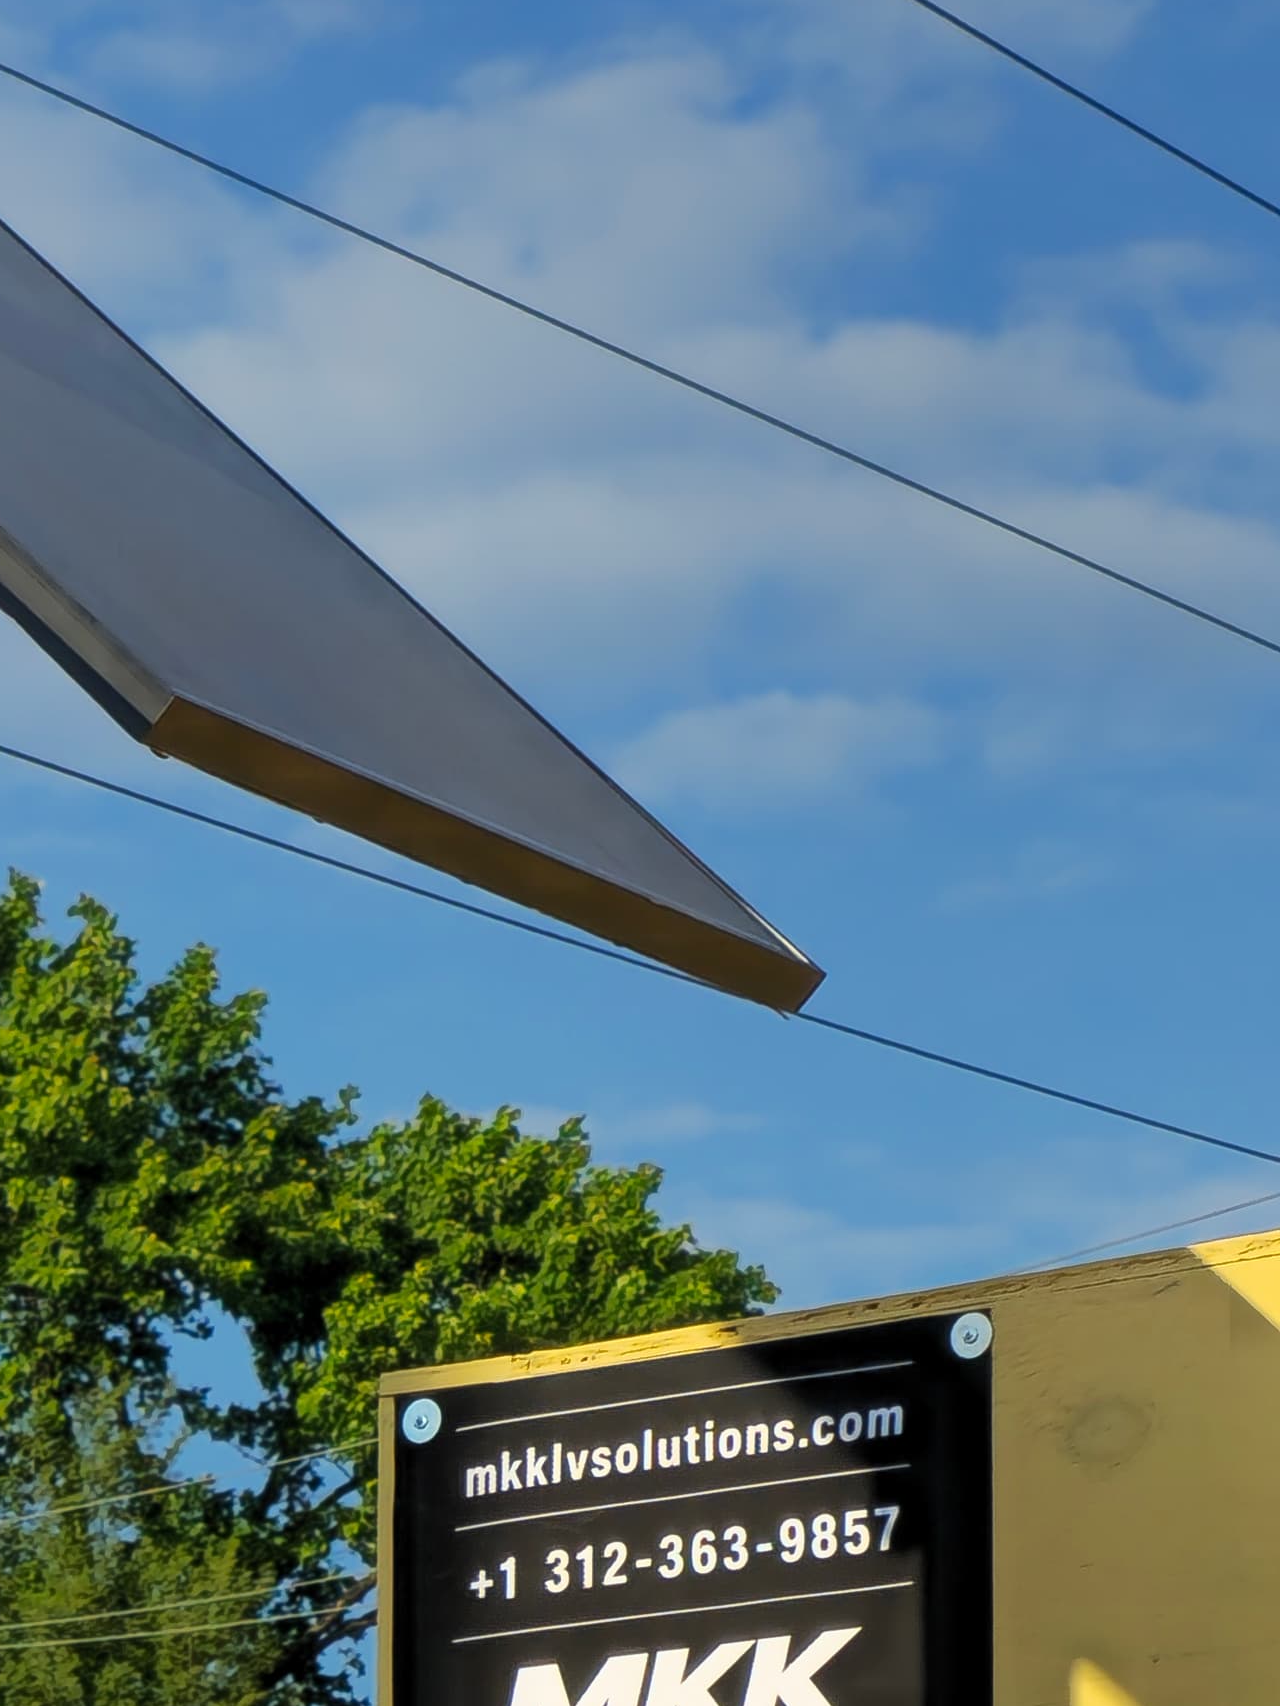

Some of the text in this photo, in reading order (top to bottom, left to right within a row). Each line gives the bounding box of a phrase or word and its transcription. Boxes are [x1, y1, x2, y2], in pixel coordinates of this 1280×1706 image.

[465, 1404, 903, 1498] mkklvsolutions.com
[469, 1505, 900, 1600] +1 312-363-9857
